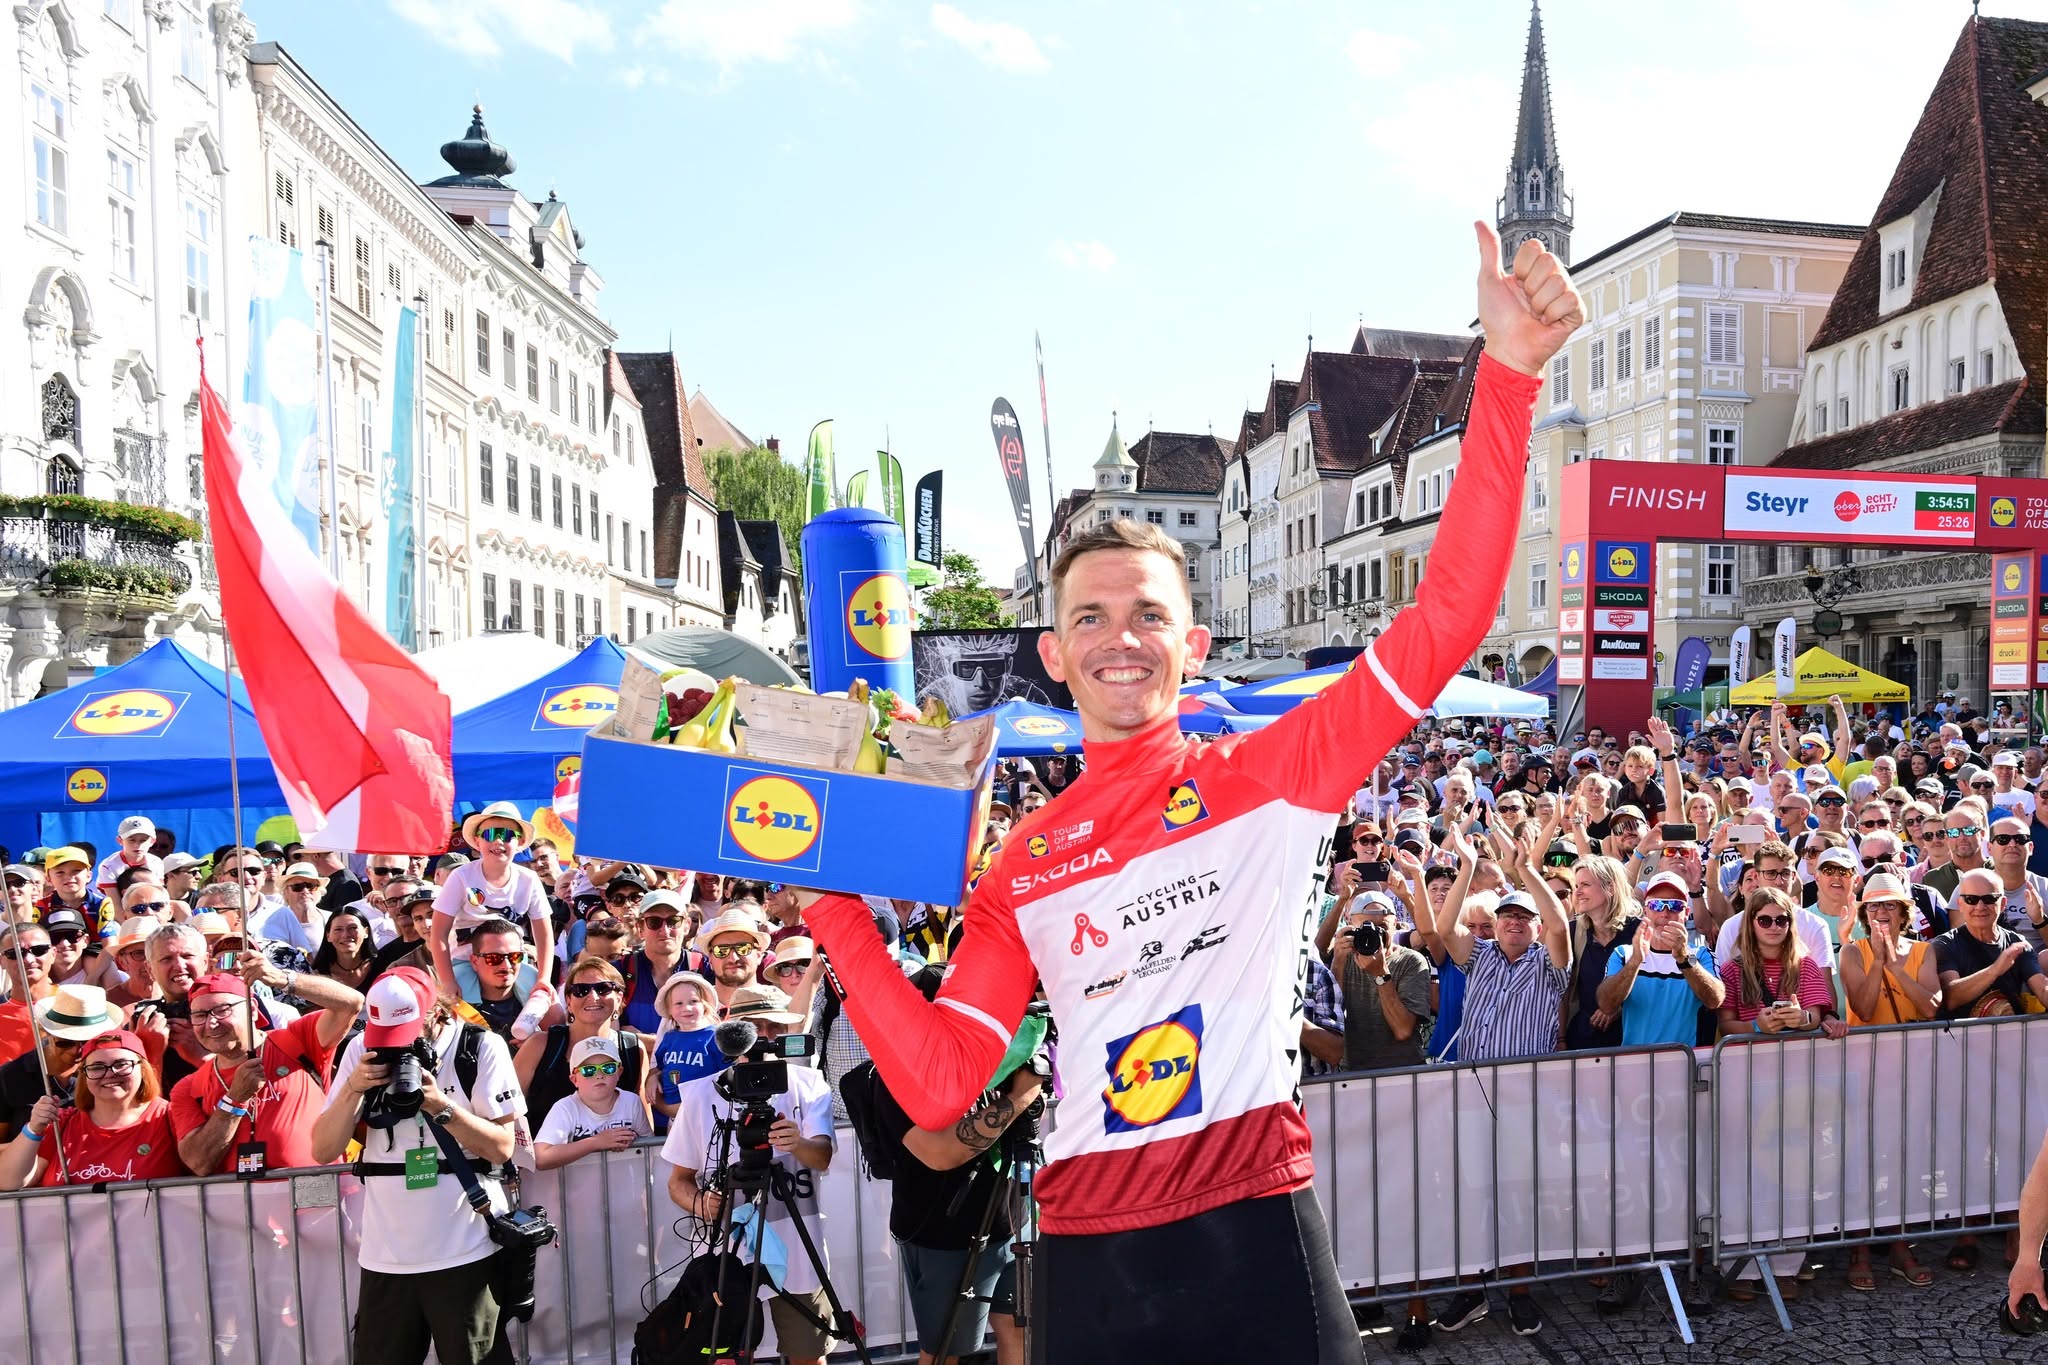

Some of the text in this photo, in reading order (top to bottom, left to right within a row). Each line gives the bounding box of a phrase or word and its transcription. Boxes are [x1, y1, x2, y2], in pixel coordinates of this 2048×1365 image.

[1608, 486, 1707, 511] FINISH
[1746, 491, 1809, 517] Steyr
[1928, 496, 1969, 509] 3:54:51
[2025, 509, 2041, 518] OF
[1938, 516, 1970, 529] 25:26
[1800, 671, 1859, 680] pb-shop.at
[1053, 824, 1091, 836] TOUR 75
[1054, 835, 1067, 845] OF
[1055, 835, 1091, 853] AUSTRIA
[1137, 875, 1197, 904] CYCLING
[1122, 880, 1221, 930] AUSTRIA
[1131, 955, 1177, 976] SAALFELDEN
[1138, 964, 1173, 979] LEOGANG
[408, 1172, 436, 1182] PRESS
